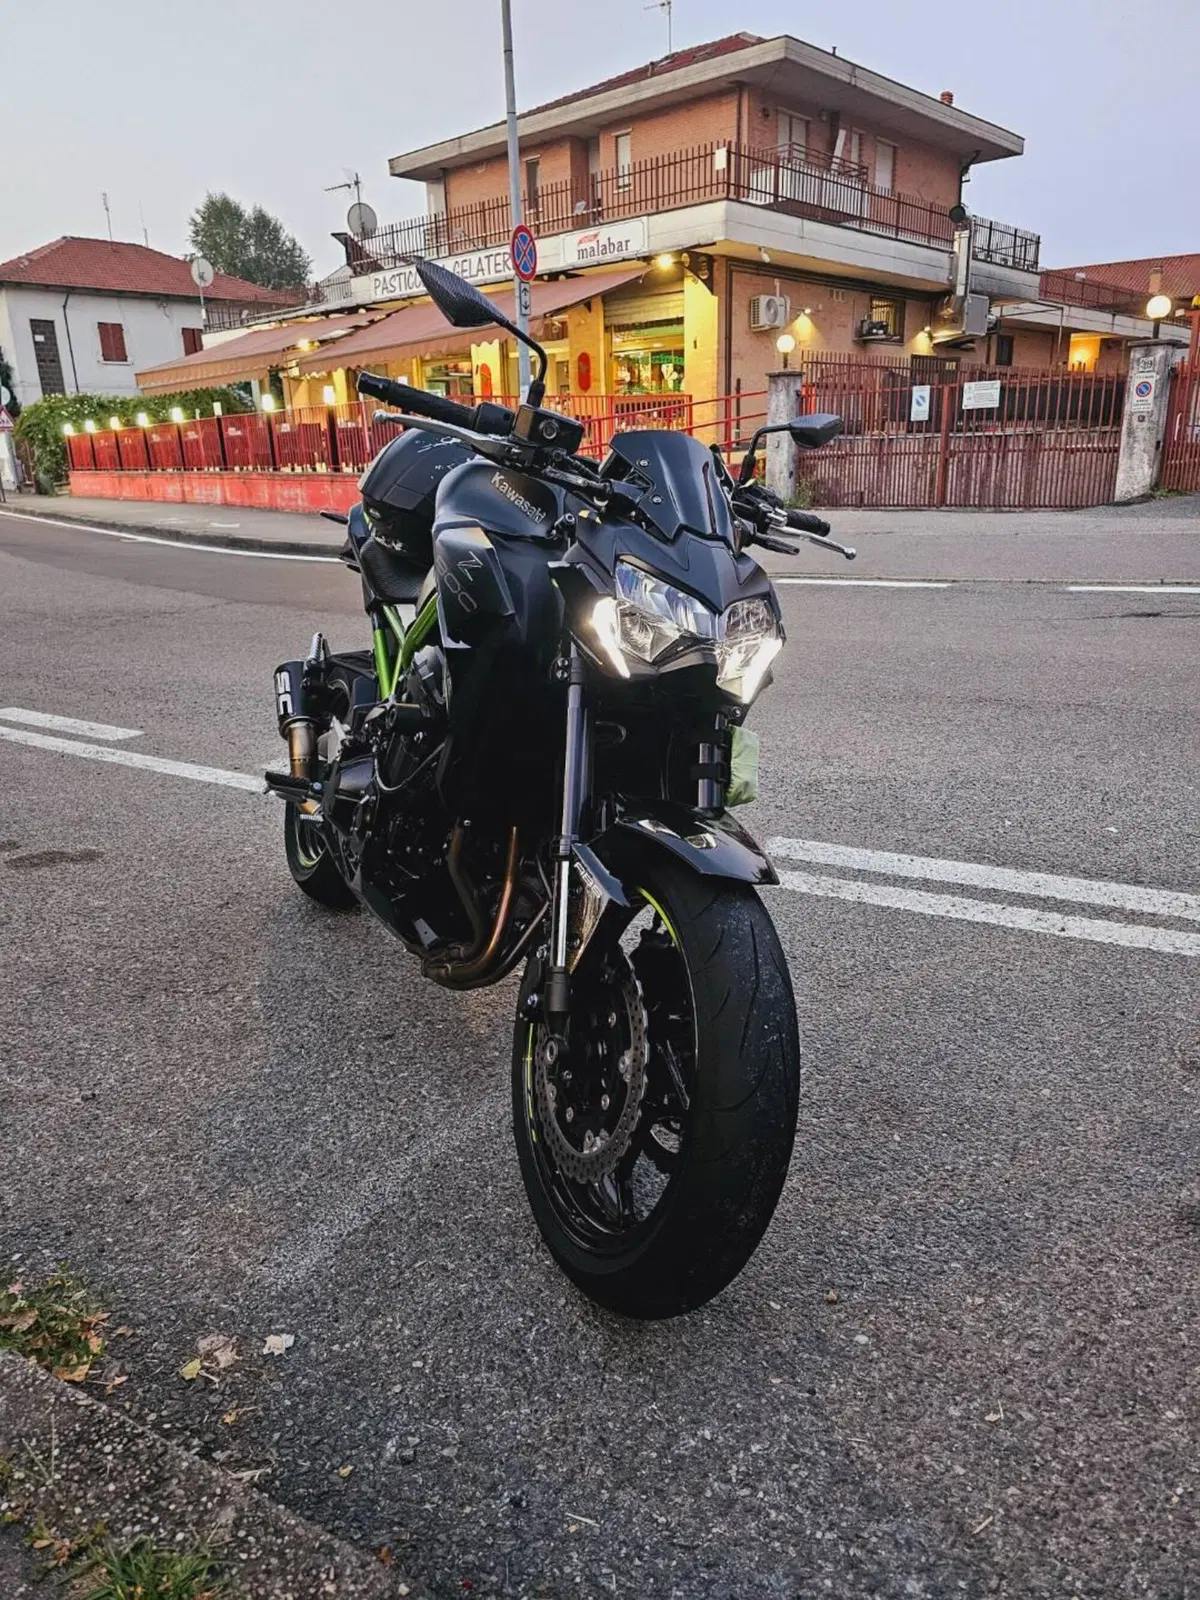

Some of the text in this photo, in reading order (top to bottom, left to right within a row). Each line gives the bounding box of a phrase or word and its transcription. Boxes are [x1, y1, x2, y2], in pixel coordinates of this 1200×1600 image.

[577, 237, 630, 260] malabar
[374, 251, 512, 294] PASTICC GELATER
[491, 471, 547, 525] Kawasaki
[573, 861, 603, 899] ABS
